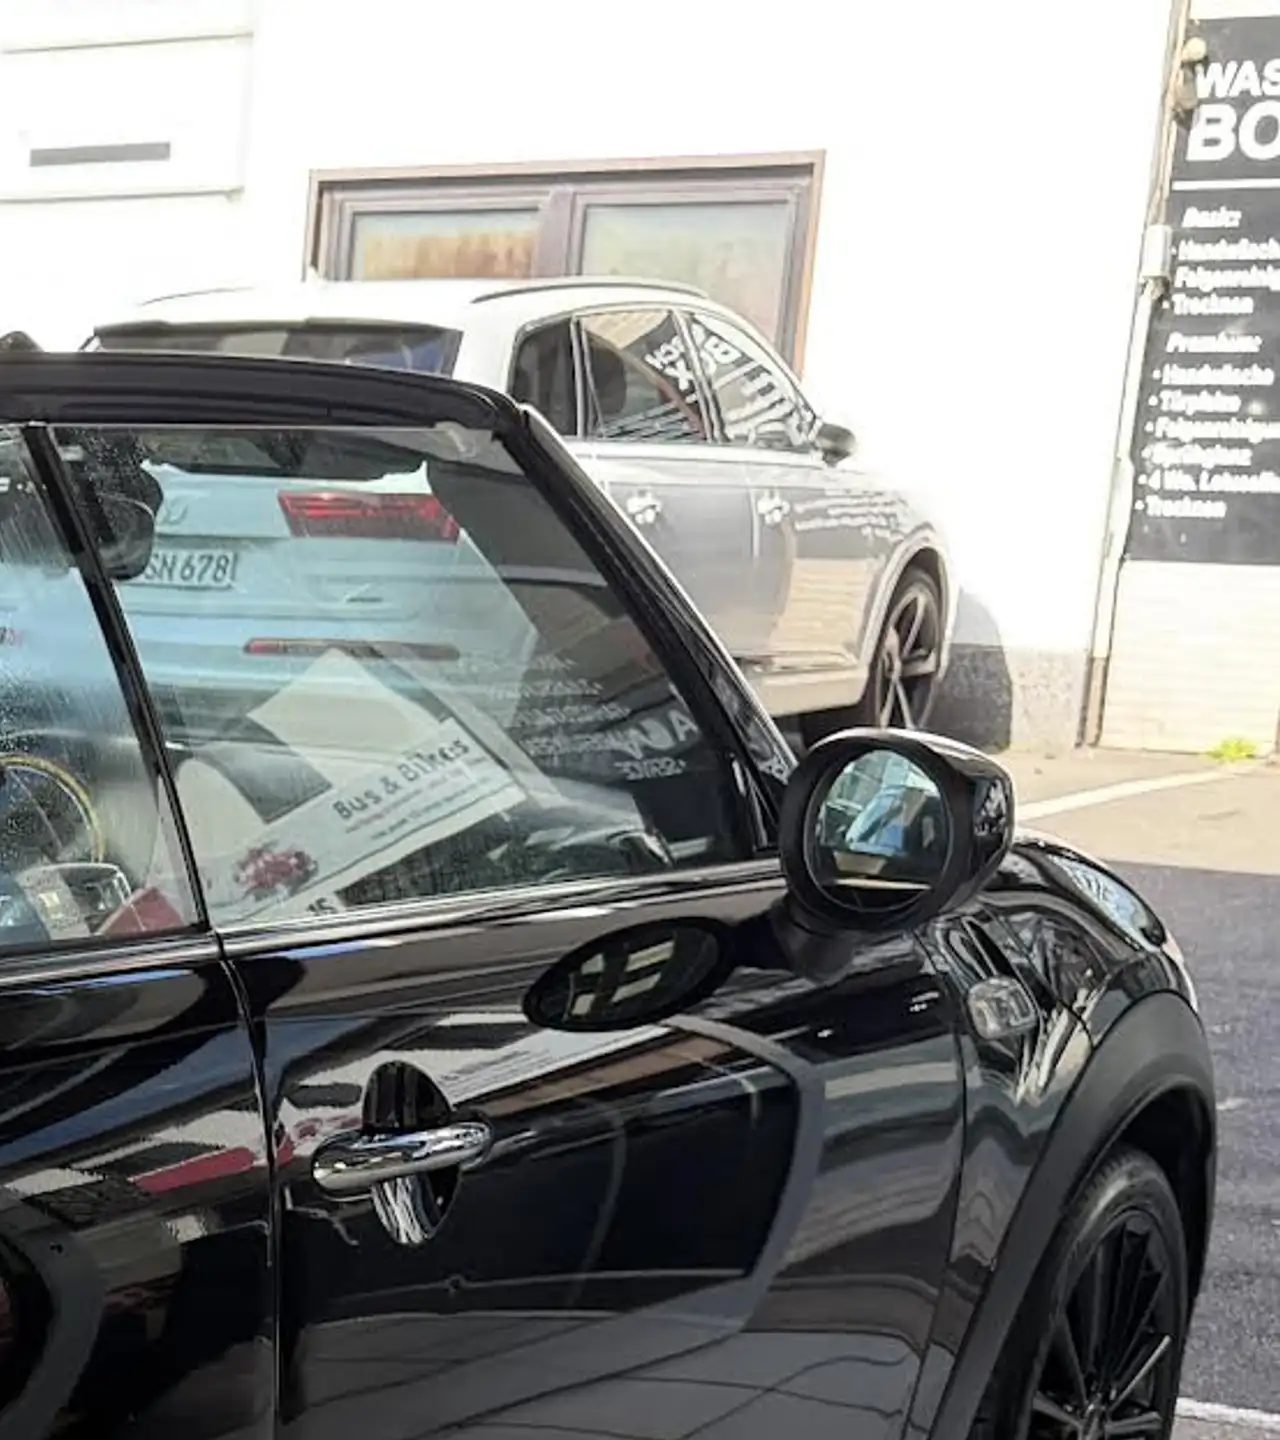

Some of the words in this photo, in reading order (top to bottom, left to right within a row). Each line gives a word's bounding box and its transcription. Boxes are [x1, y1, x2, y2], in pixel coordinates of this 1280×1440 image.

[1194, 58, 1280, 99] WAS
[1185, 99, 1280, 162] BO
[179, 553, 230, 582] 678
[332, 787, 383, 820] Bus
